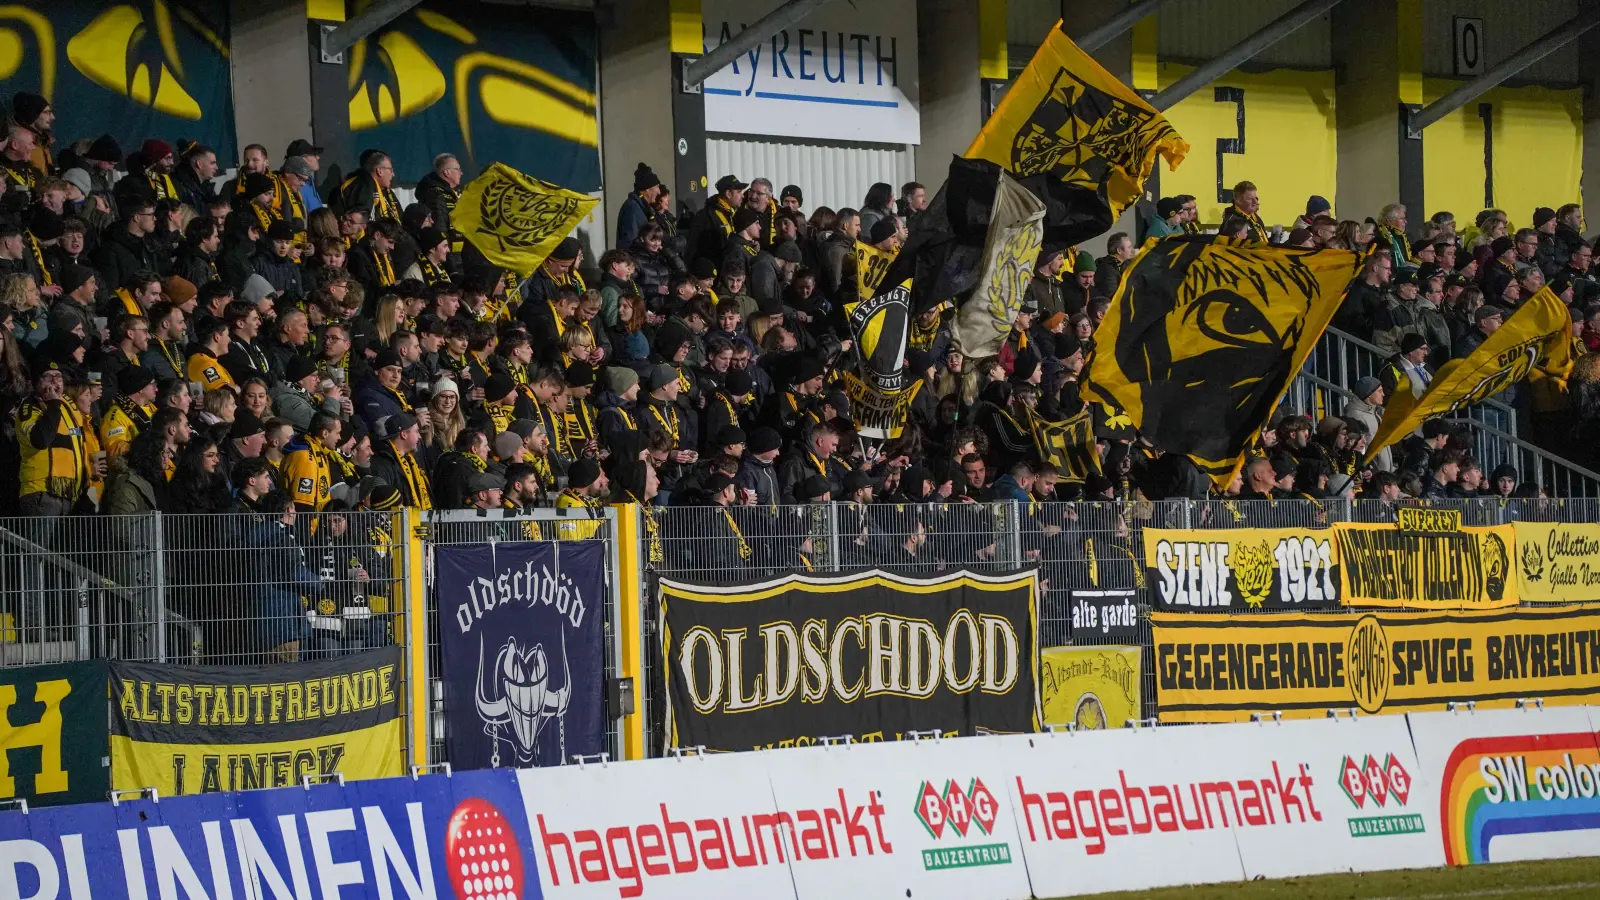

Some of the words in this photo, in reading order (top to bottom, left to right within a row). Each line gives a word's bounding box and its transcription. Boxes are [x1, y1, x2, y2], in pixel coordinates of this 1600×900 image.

[855, 288, 910, 322] GEGENGE
[1547, 529, 1600, 562] Collettivo
[1156, 539, 1232, 607] SZENE
[1273, 535, 1336, 603] 1921
[1549, 563, 1578, 594] Giallo
[456, 561, 586, 633] oldschdöd
[1072, 599, 1098, 629] alte
[1101, 598, 1137, 633] garde
[1158, 642, 1346, 691] GEGENGERADE
[1392, 637, 1475, 687] SPVGG
[1486, 629, 1600, 682] BAYREUTH
[120, 664, 396, 726] ALTSTADTFREUNDE
[1347, 763, 1407, 795] BHG
[1480, 755, 1530, 804] SW
[926, 787, 993, 826] BHG
[1016, 761, 1323, 856] hagebaumarkt
[1350, 815, 1423, 836] BAUZENTRUM
[536, 788, 893, 899] hagebaumarkt
[925, 843, 1010, 865] BAUZENTRUM
